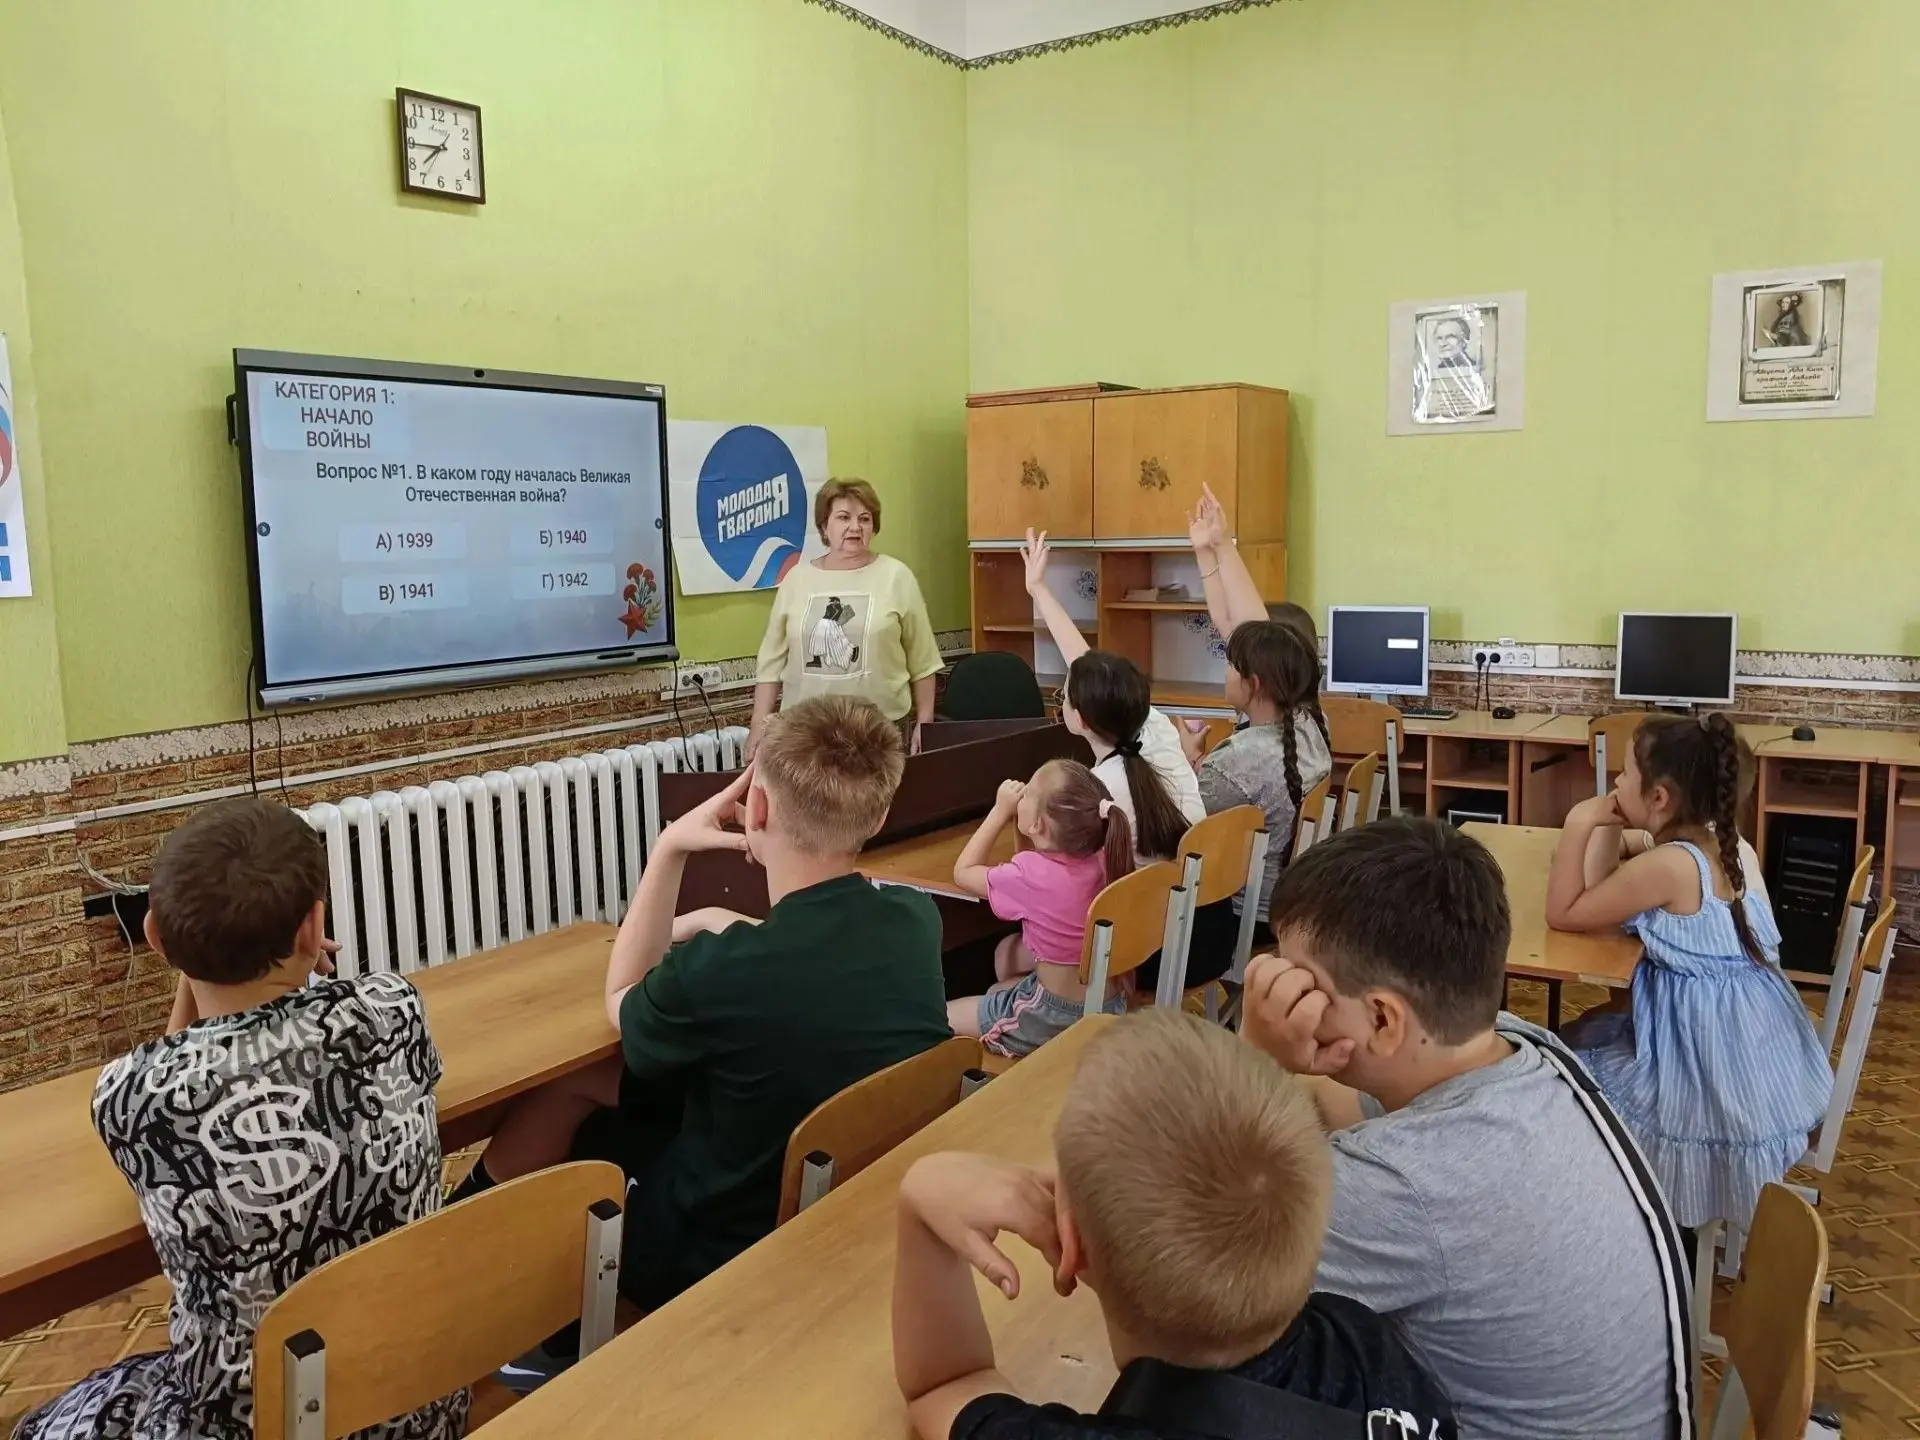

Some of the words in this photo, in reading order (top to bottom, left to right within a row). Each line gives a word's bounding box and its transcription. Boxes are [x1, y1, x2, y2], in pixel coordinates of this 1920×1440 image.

[412, 103, 425, 118] 11
[430, 107, 445, 123] 12
[452, 112, 459, 125] 1
[407, 136, 415, 149] 9
[462, 128, 469, 141] 2
[463, 148, 470, 160] 3
[409, 157, 417, 170] 8
[419, 172, 427, 185] 7
[437, 175, 445, 188] 6
[464, 168, 471, 181] 4
[455, 179, 463, 192] 5
[275, 381, 376, 403] КАТЕГОРИЯ
[381, 388, 395, 404] 1:
[301, 407, 373, 426] НАЧАЛО
[306, 428, 371, 449] ВОЙНЫ
[316, 462, 378, 483] Вопрос
[382, 463, 412, 480] №1.
[417, 464, 426, 480] В
[431, 467, 476, 481] каком
[481, 469, 511, 484] году
[515, 469, 577, 483] началась
[580, 468, 631, 484] Великая
[405, 486, 516, 503] Отечественная
[520, 487, 567, 503] война?
[717, 473, 789, 519] МОЛОДАЯ
[376, 532, 393, 552] А)
[397, 532, 434, 549] 1939
[539, 529, 553, 547] Б)
[556, 529, 587, 545] 1940
[541, 573, 555, 591] Г)
[558, 573, 588, 588] 1942
[378, 584, 395, 604] В)
[399, 582, 434, 600] 1941
